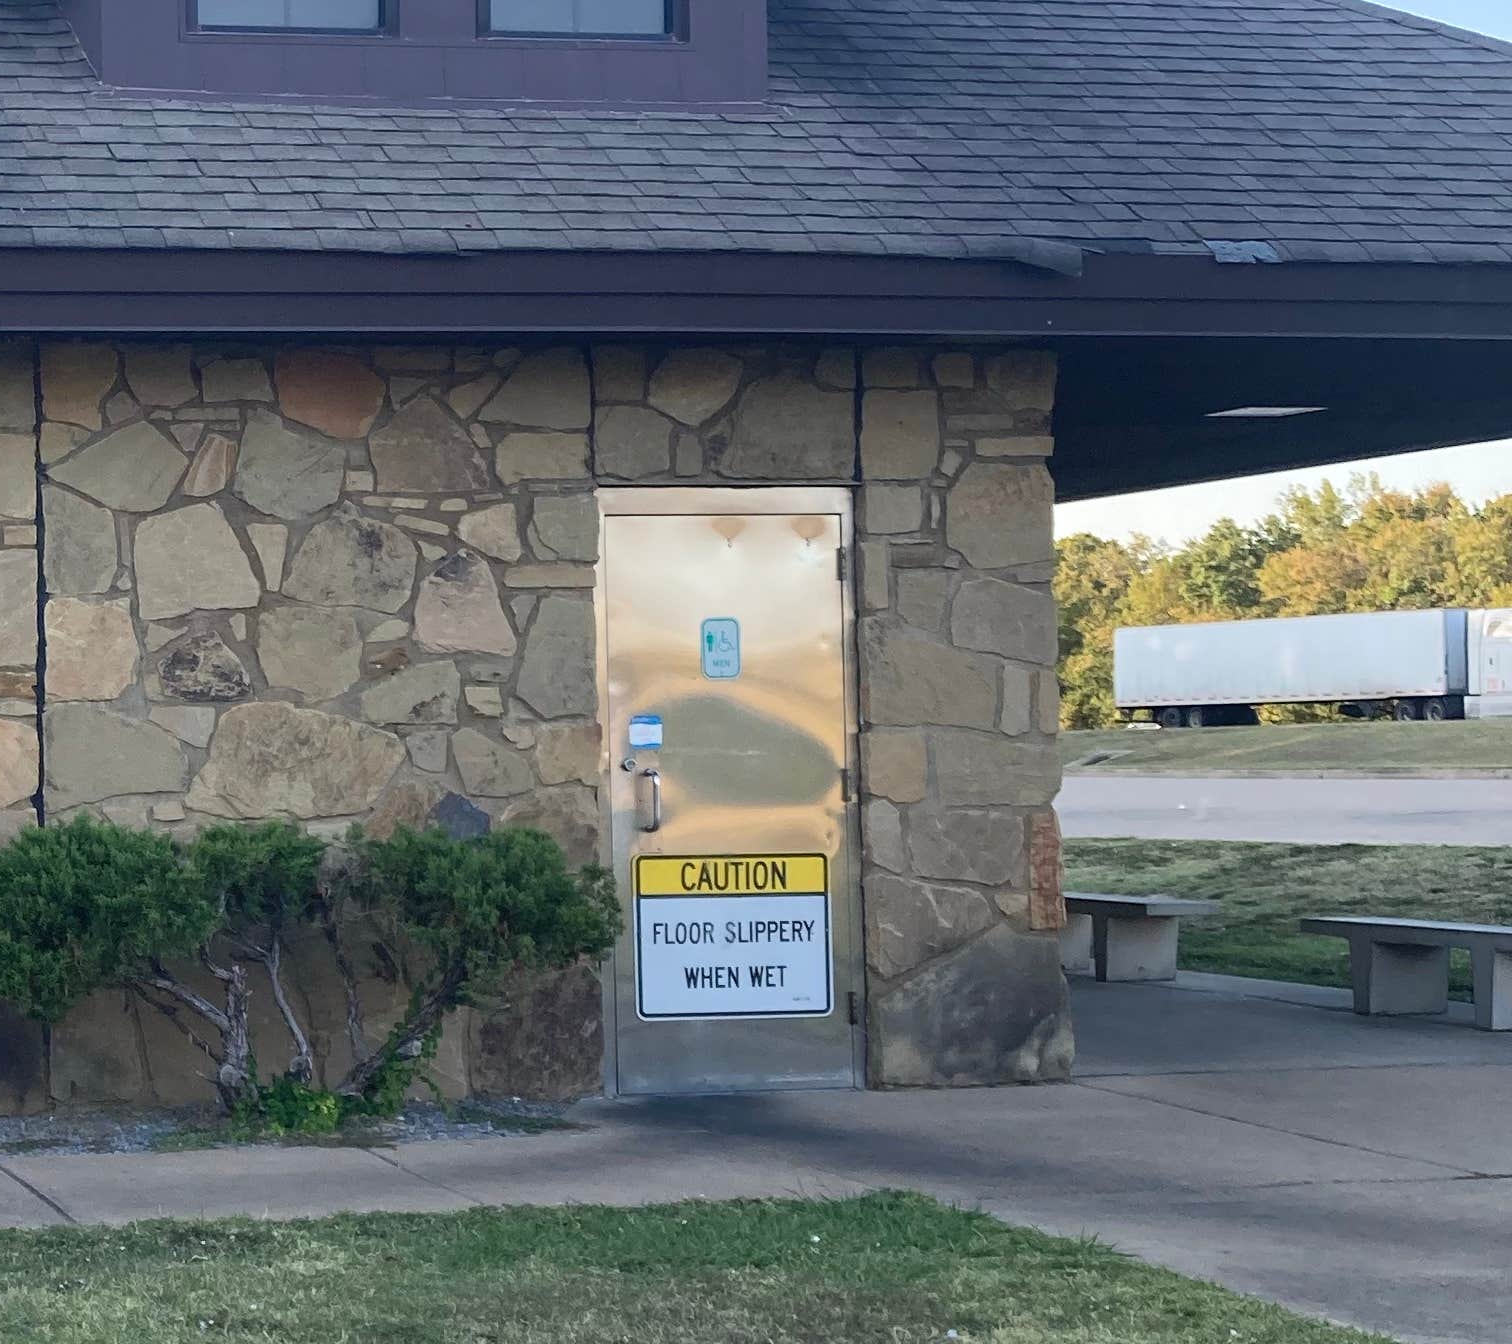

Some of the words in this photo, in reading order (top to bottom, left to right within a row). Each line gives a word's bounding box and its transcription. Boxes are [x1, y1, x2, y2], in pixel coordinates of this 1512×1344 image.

[681, 861, 787, 891] CAUTION
[653, 922, 715, 945] FLOOR
[724, 920, 815, 944] SLIPPERY
[684, 966, 740, 989] WHEN
[749, 965, 788, 988] WET
